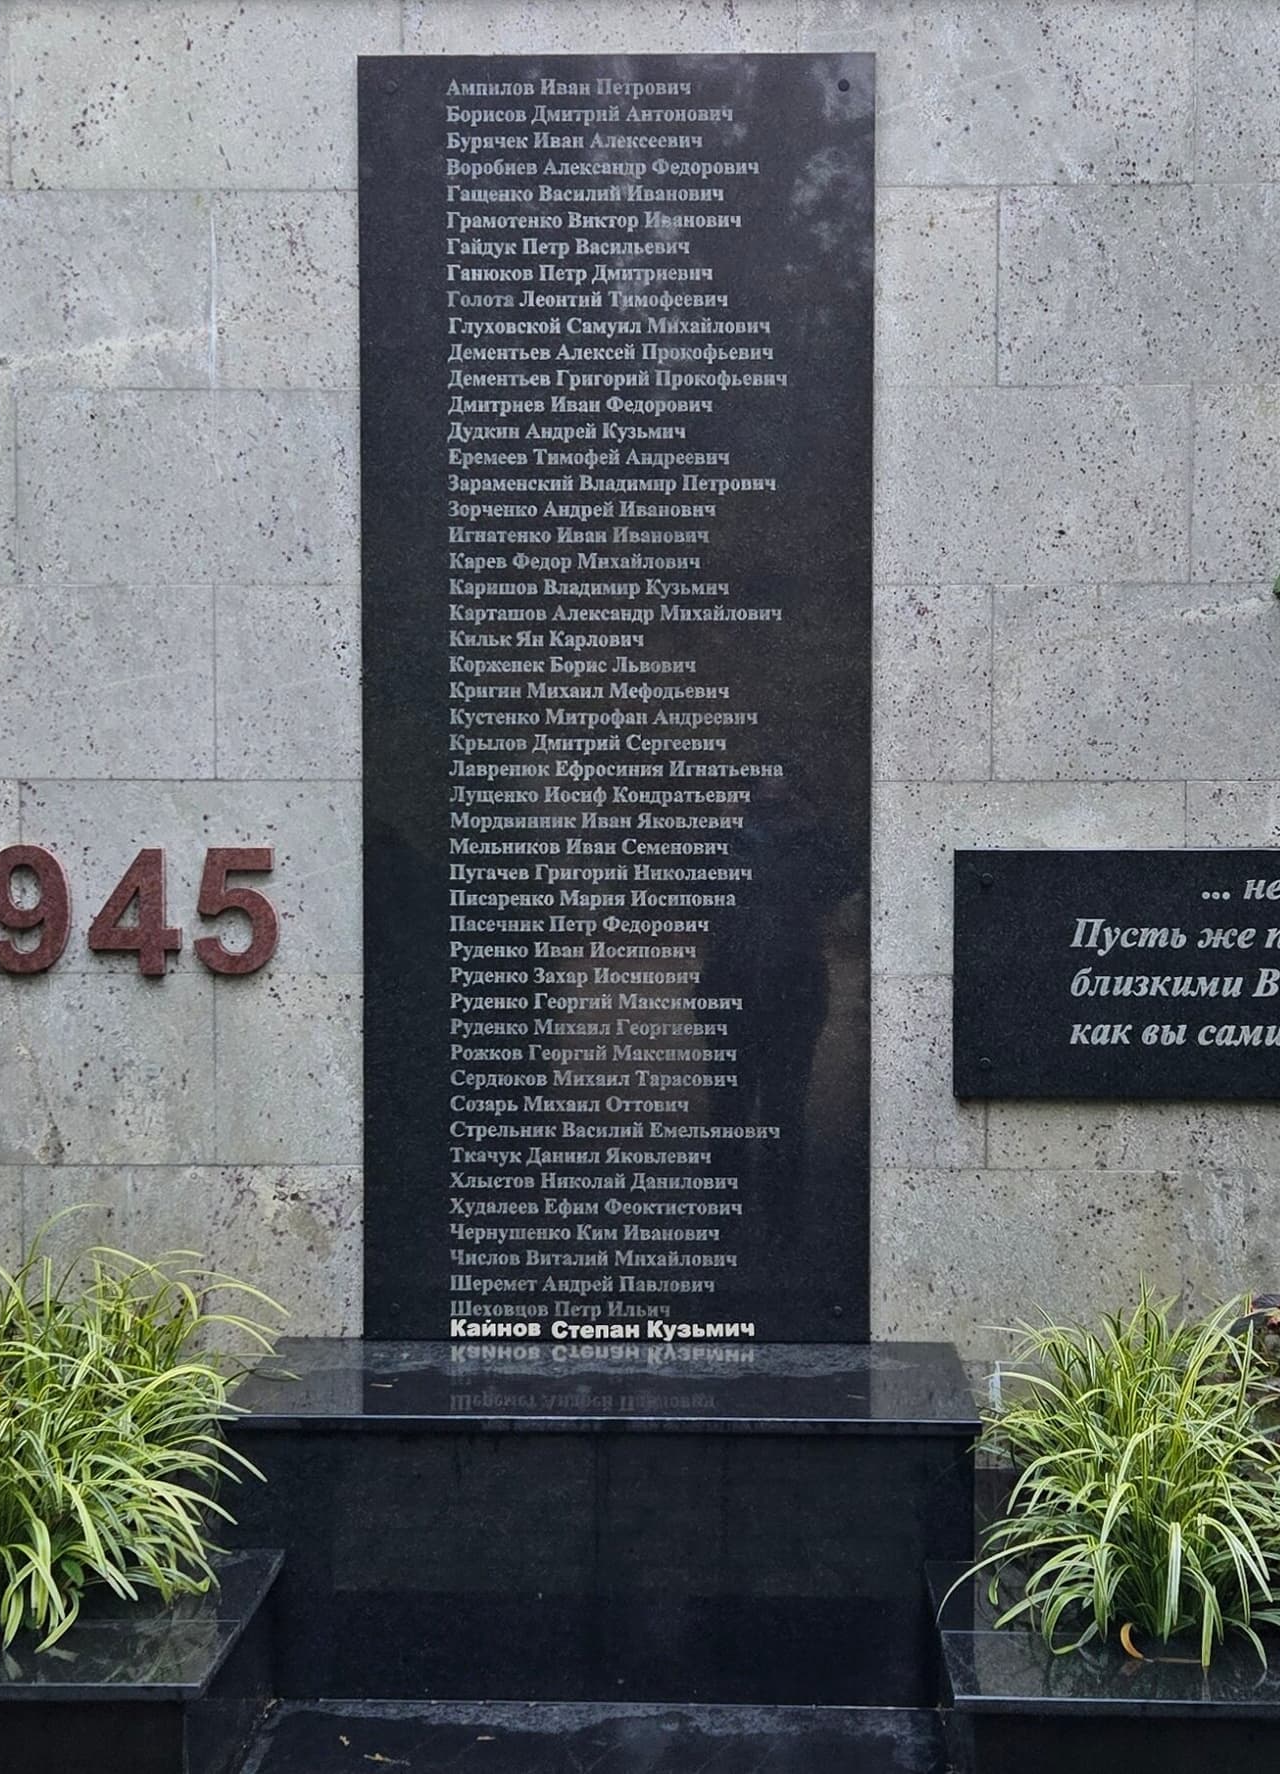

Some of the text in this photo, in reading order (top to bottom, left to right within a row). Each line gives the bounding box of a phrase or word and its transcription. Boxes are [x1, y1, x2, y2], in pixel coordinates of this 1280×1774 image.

[540, 79, 591, 96] Иван
[596, 79, 692, 101] Петрович
[446, 106, 733, 127] Борисов Дмитрий Антонович
[446, 132, 703, 154] Бурячек Иван Алексеевич
[446, 211, 742, 233] Грамотенко Виктор Иванович
[446, 238, 690, 259] Гайдук Петр Васильевич
[539, 264, 588, 285] Петр
[593, 264, 713, 285] Дмитриевич
[448, 317, 771, 338] Глуховской Самуил Михайлович
[450, 343, 774, 364] Дементьев Алексей Прокофьевич
[449, 369, 788, 391] Дементьев Григорий Прокофьевич
[449, 396, 713, 417] Дмитриев Иван Федорович
[448, 422, 686, 443] Дудкин Андрей Кузьмич
[448, 448, 730, 469] Еремеев Тимофей Андреевич
[579, 474, 677, 495] Владимир
[682, 474, 777, 495] Петрович
[543, 500, 614, 521] Андрей
[619, 500, 716, 516] Иванович
[449, 552, 701, 574] Карев Федор Михайлович
[449, 605, 782, 626] Карташов Александр Михайлович
[515, 631, 544, 647] Ян
[549, 631, 645, 652] Карлович
[545, 709, 648, 730] Митрофан
[654, 709, 758, 730] Андреевич
[449, 735, 727, 755] Крылов Дмитрий Сергеевич
[449, 786, 751, 807] Лущенко Иосиф Кондратьевич
[449, 838, 728, 854] Мельников Иван Семенович
[449, 864, 753, 885] Пугачев Григорий Николаевич
[450, 890, 555, 911] Писаренко
[559, 890, 626, 911] Мария
[1069, 917, 1188, 956] Пусть
[1197, 927, 1256, 949] же
[449, 941, 529, 962] Руденко
[533, 941, 584, 957] Иван
[1070, 966, 1244, 997] близкими
[450, 993, 743, 1014] Руденко Георгий Максимович
[1069, 1023, 1132, 1045] как
[1141, 1024, 1186, 1045] вы
[450, 1044, 737, 1065] Рожков Георгий Максимович
[553, 1070, 630, 1086] Михаил
[635, 1070, 738, 1091] Тарасович
[523, 1096, 601, 1111] Михаил
[605, 1096, 689, 1111] Оттович
[449, 1121, 781, 1142] Стрельник Василий Емельянович
[449, 1147, 712, 1167] Ткачук Даниил Яковлевич
[540, 1172, 626, 1188] Николай
[632, 1172, 739, 1191] Данилович
[544, 1198, 599, 1219] Ефим
[604, 1198, 743, 1214] Феоктистович
[450, 1224, 720, 1244] Чернушенко Ким Иванович
[450, 1249, 737, 1265] Числов Виталий Михайлович
[450, 1275, 715, 1295] Шеремет Андрей Павлович
[554, 1301, 602, 1319] Петр
[607, 1301, 671, 1317] Ильич
[450, 1318, 755, 1341] Кайнов Степан Кузьмич
